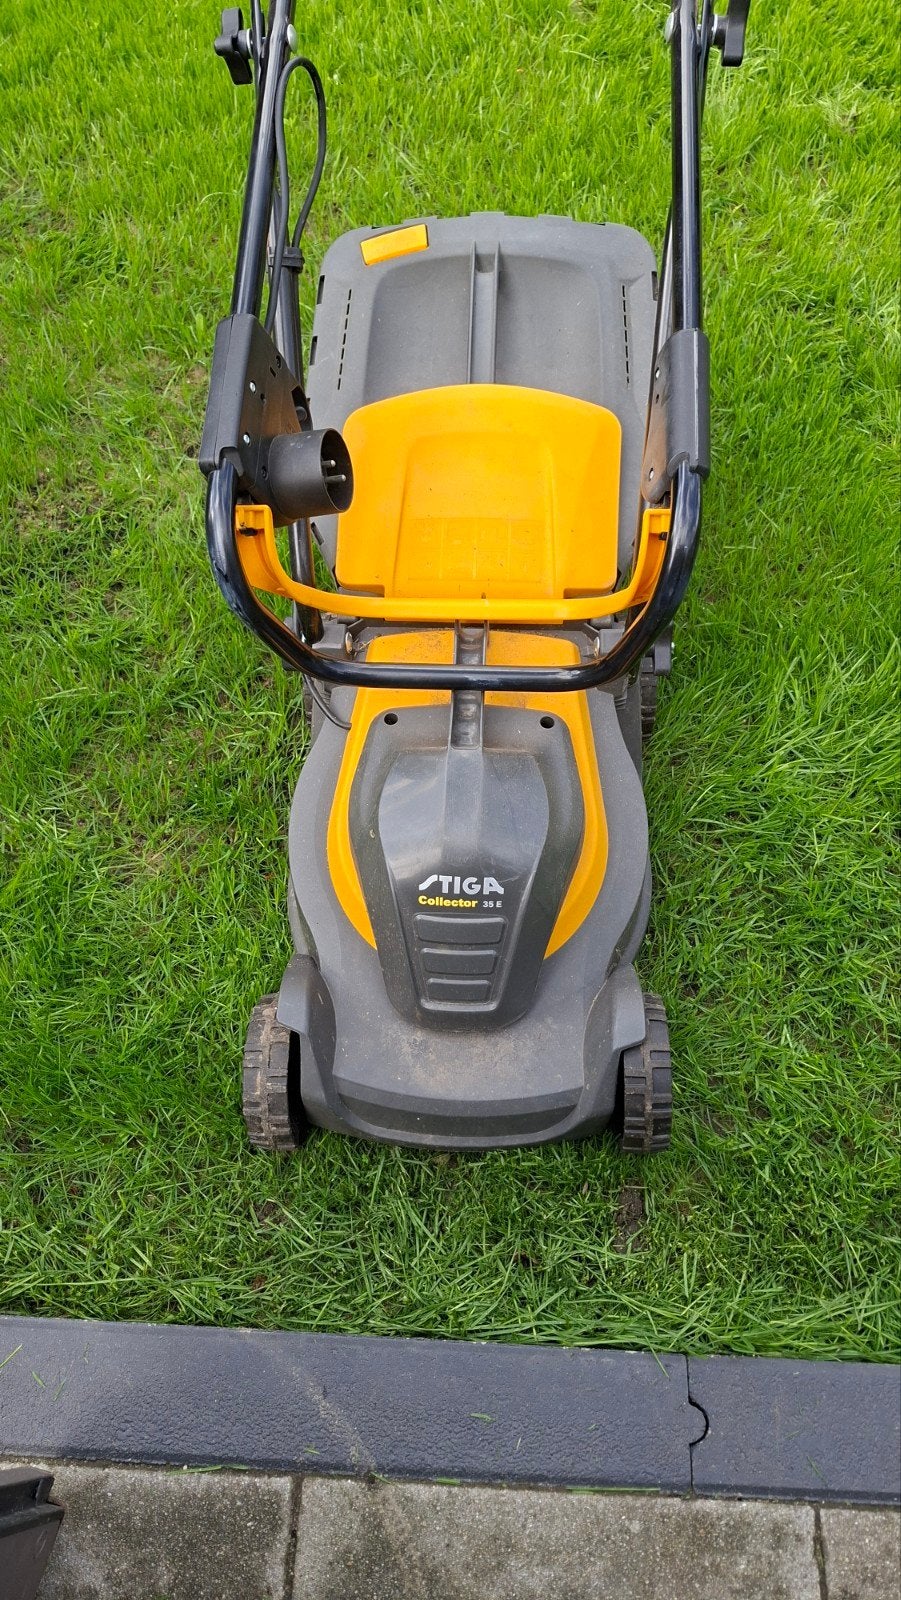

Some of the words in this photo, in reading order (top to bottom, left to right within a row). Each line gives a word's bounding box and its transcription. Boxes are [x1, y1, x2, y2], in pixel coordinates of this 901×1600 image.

[418, 874, 505, 895] STIGA
[418, 895, 478, 908] Collector
[482, 900, 495, 908] 35
[496, 900, 503, 908] E
